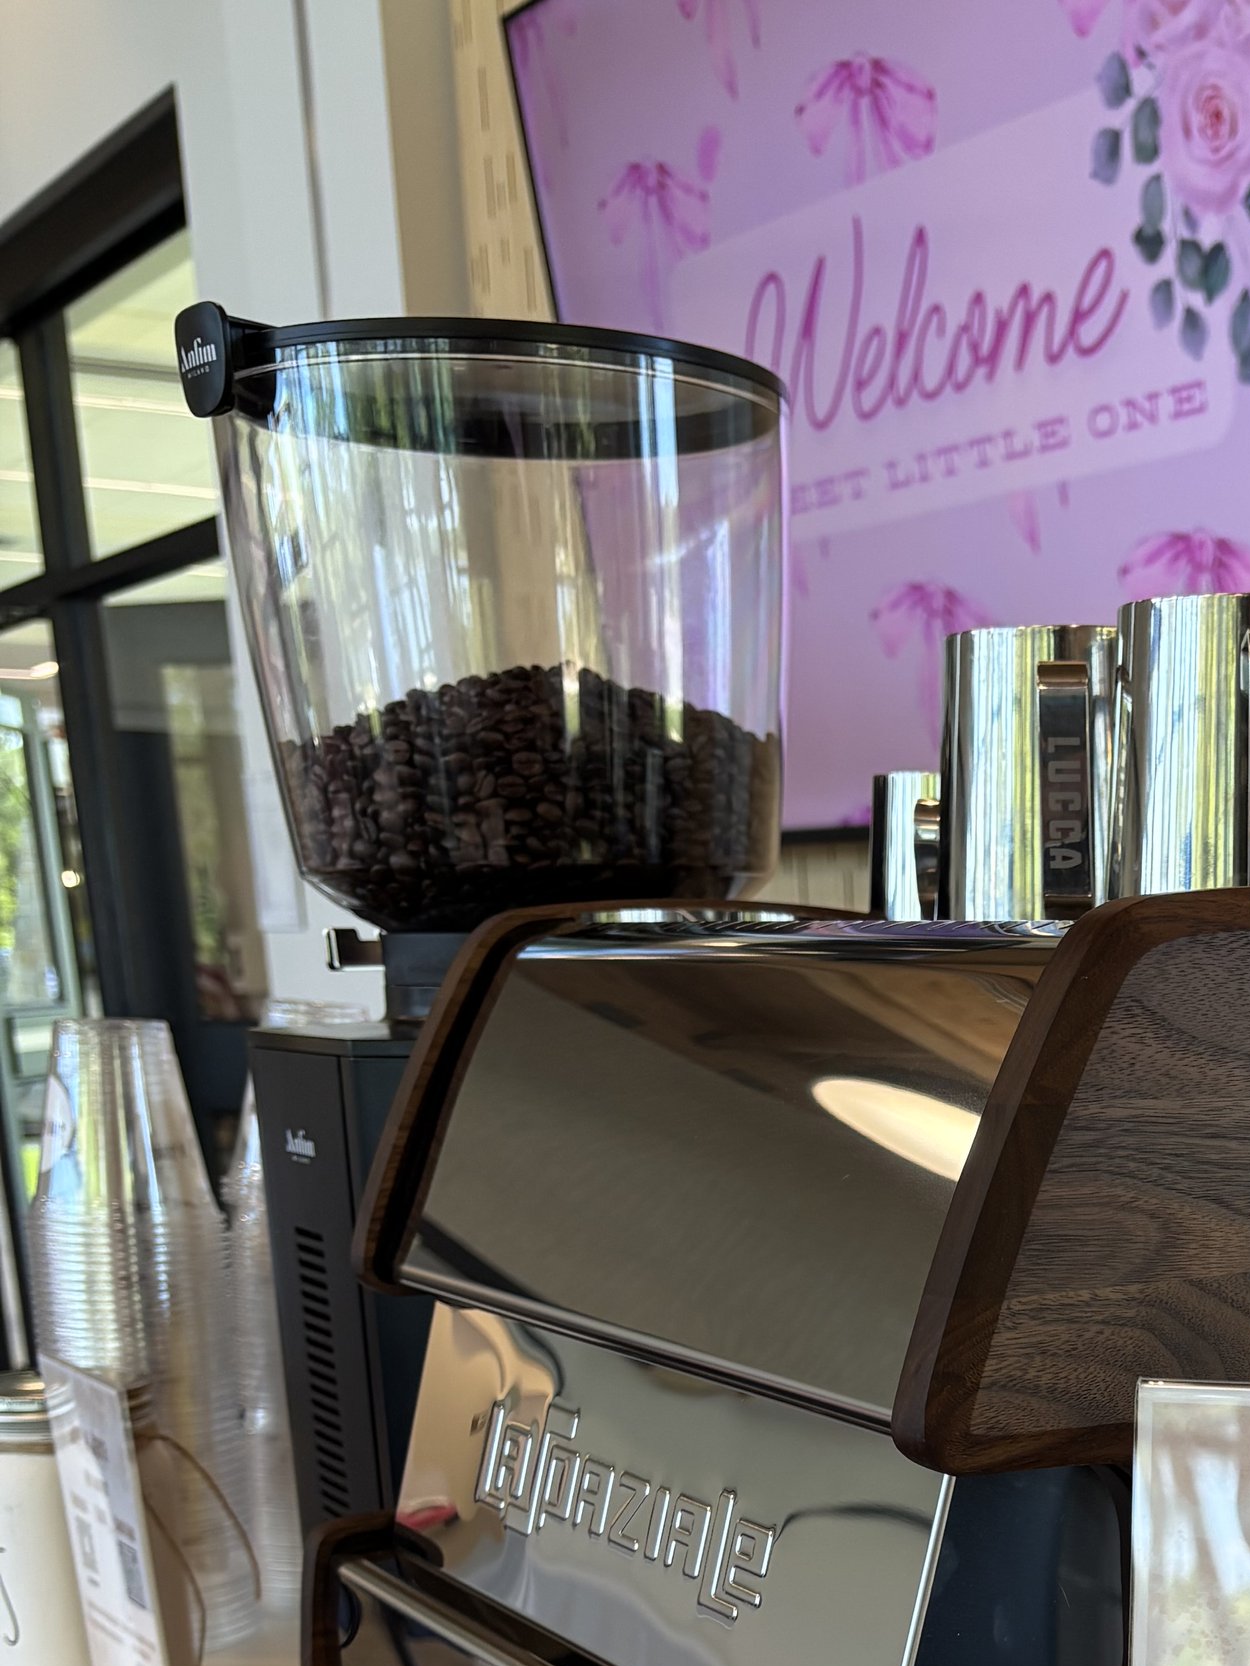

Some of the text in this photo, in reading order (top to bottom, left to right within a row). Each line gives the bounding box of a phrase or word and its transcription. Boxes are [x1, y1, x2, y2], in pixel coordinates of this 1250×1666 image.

[745, 214, 1131, 432] Welcome
[790, 380, 1208, 516] EET LITTLE ONE
[1047, 736, 1083, 870] LUCCA
